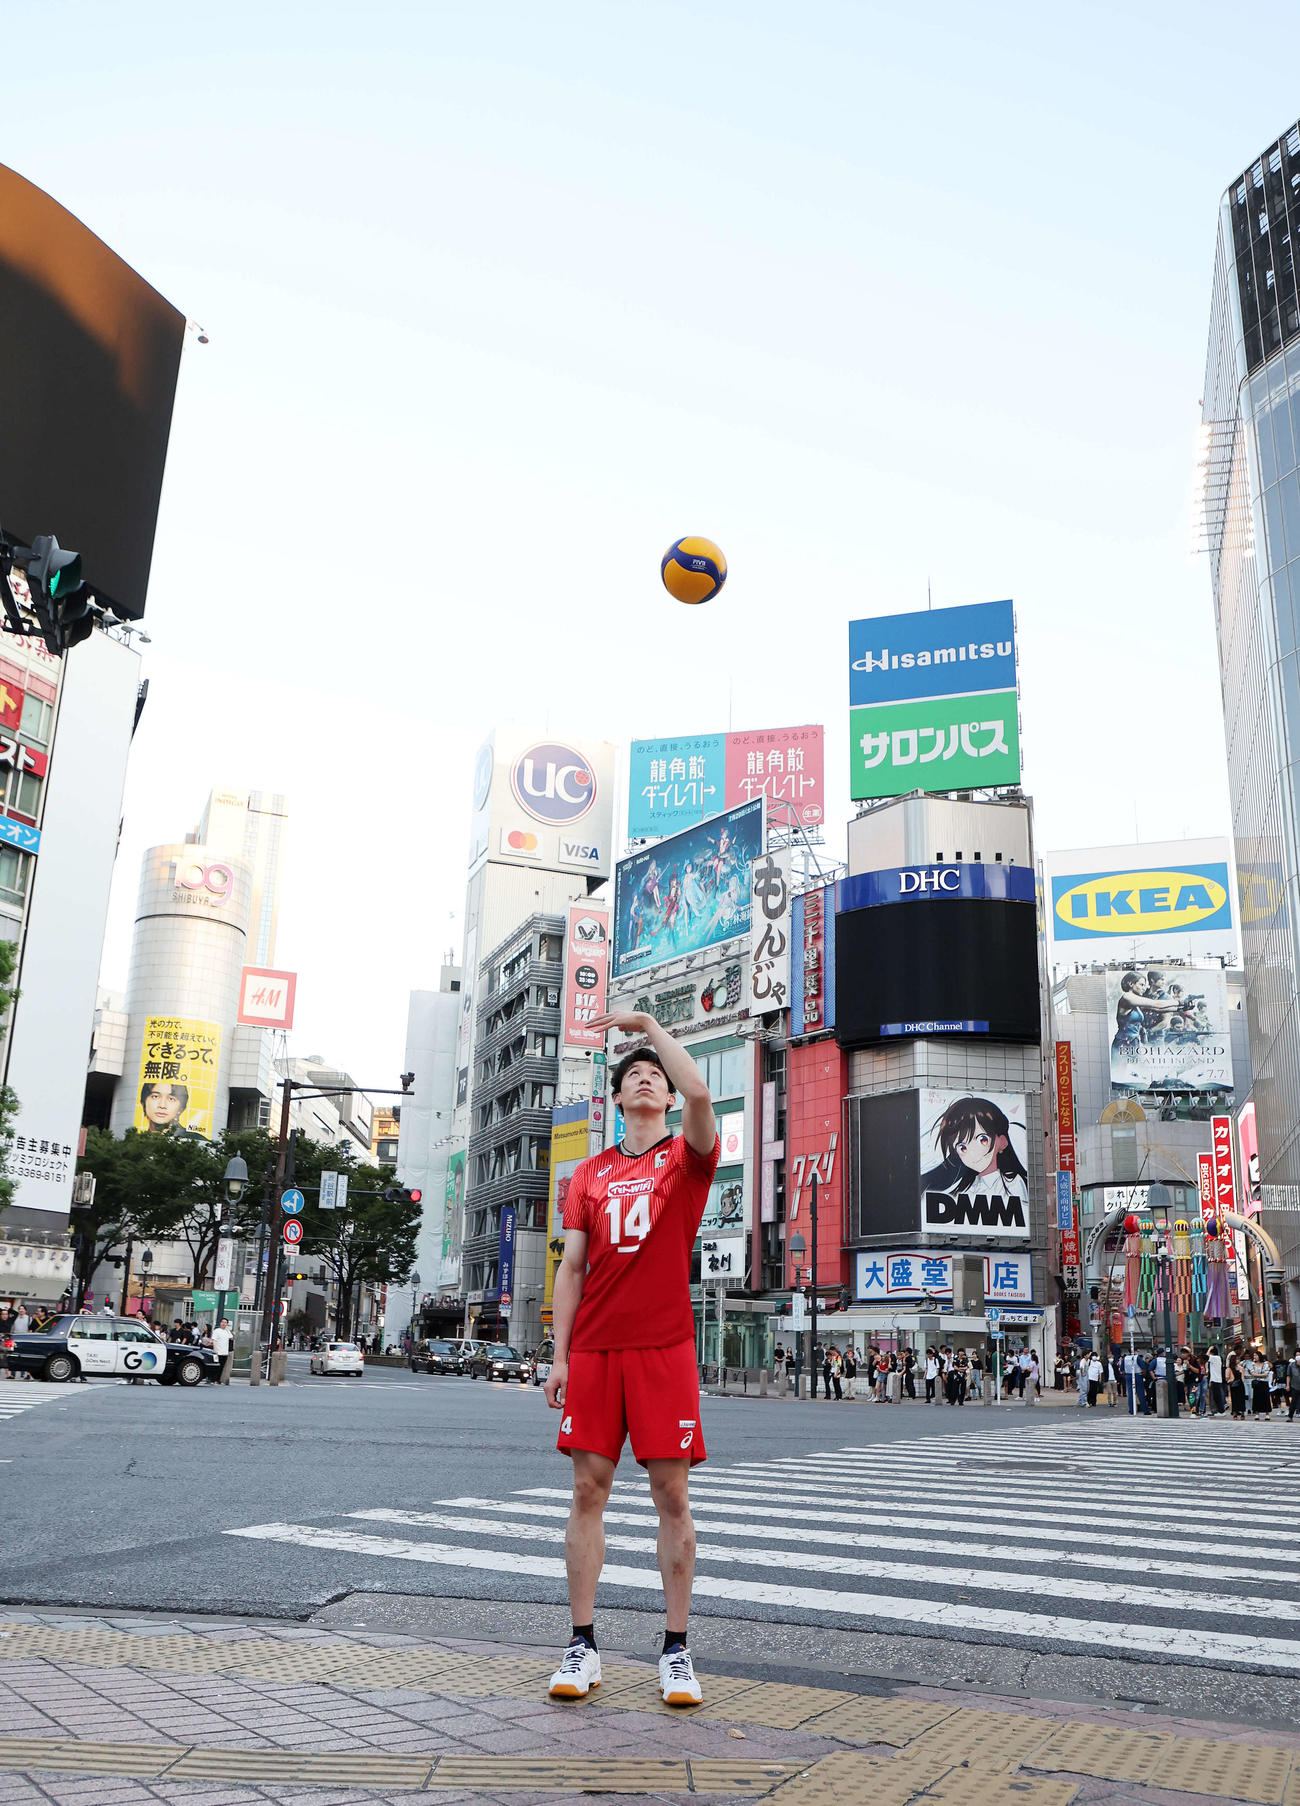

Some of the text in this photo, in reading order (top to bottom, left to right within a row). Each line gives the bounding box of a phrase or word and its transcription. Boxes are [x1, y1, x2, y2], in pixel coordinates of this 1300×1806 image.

[851, 641, 1012, 673] Hisamitsu
[860, 719, 1009, 769] サロンパス
[650, 754, 706, 783] 龍角散
[746, 747, 804, 775] 龍角散
[523, 758, 589, 804] UC
[564, 843, 600, 861] VISA
[898, 869, 960, 893] DHC
[171, 891, 210, 907] SHIBUYA
[1071, 884, 1216, 919] IKEA
[753, 855, 788, 1006] もんじゃ
[251, 987, 281, 1008] H&M
[904, 1022, 963, 1032] DHC Channel
[146, 1042, 214, 1065] できるって、
[1119, 1045, 1225, 1056] BIOHAZARD
[143, 1060, 188, 1081] 無限。
[1206, 1068, 1225, 1080] 7.7
[1058, 1044, 1071, 1127] クスリのことなら
[187, 1123, 206, 1132] Nikon
[1215, 1125, 1233, 1196] カラオケ
[604, 1195, 651, 1245] 14
[926, 1192, 1026, 1227] DMM
[865, 1259, 1019, 1290] 大盛堂店
[124, 1351, 157, 1371] GO
[561, 1416, 572, 1435] 4
